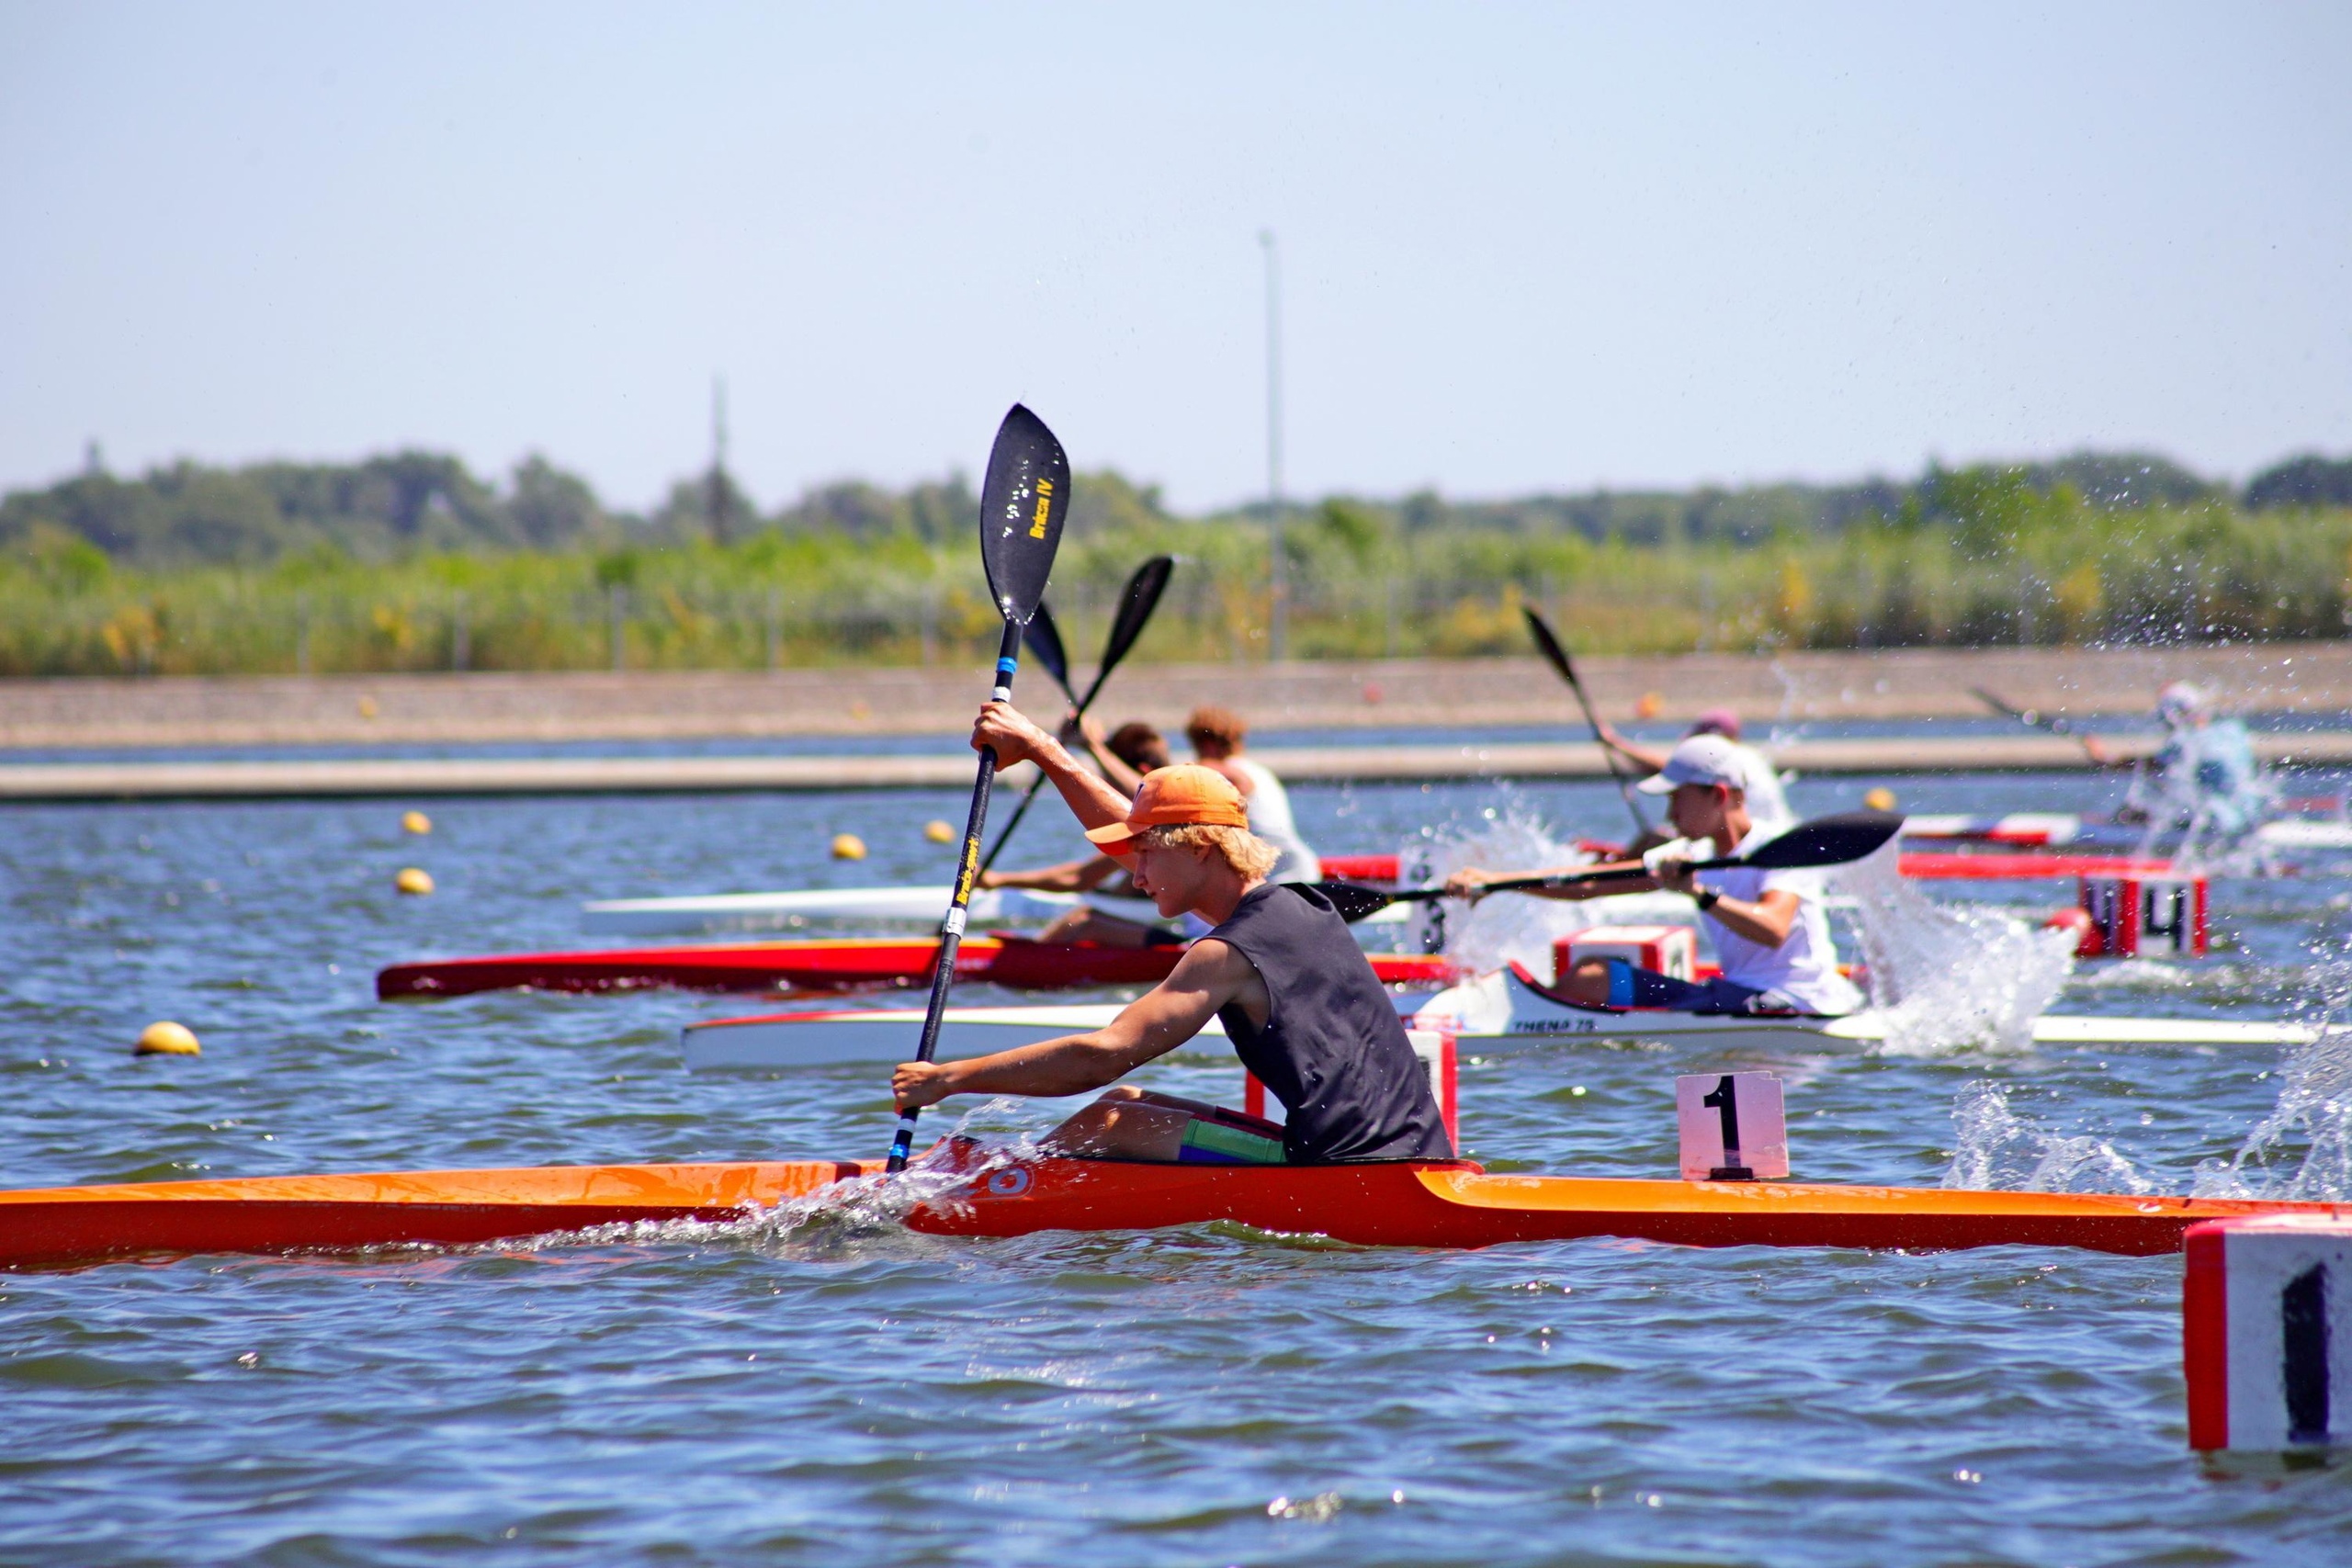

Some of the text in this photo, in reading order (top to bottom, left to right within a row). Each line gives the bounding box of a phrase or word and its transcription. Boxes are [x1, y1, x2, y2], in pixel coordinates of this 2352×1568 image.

[1035, 478, 1054, 497] IV
[2146, 884, 2186, 952] 4
[1703, 1076, 1741, 1168] 1
[2282, 1260, 2331, 1443] 1
